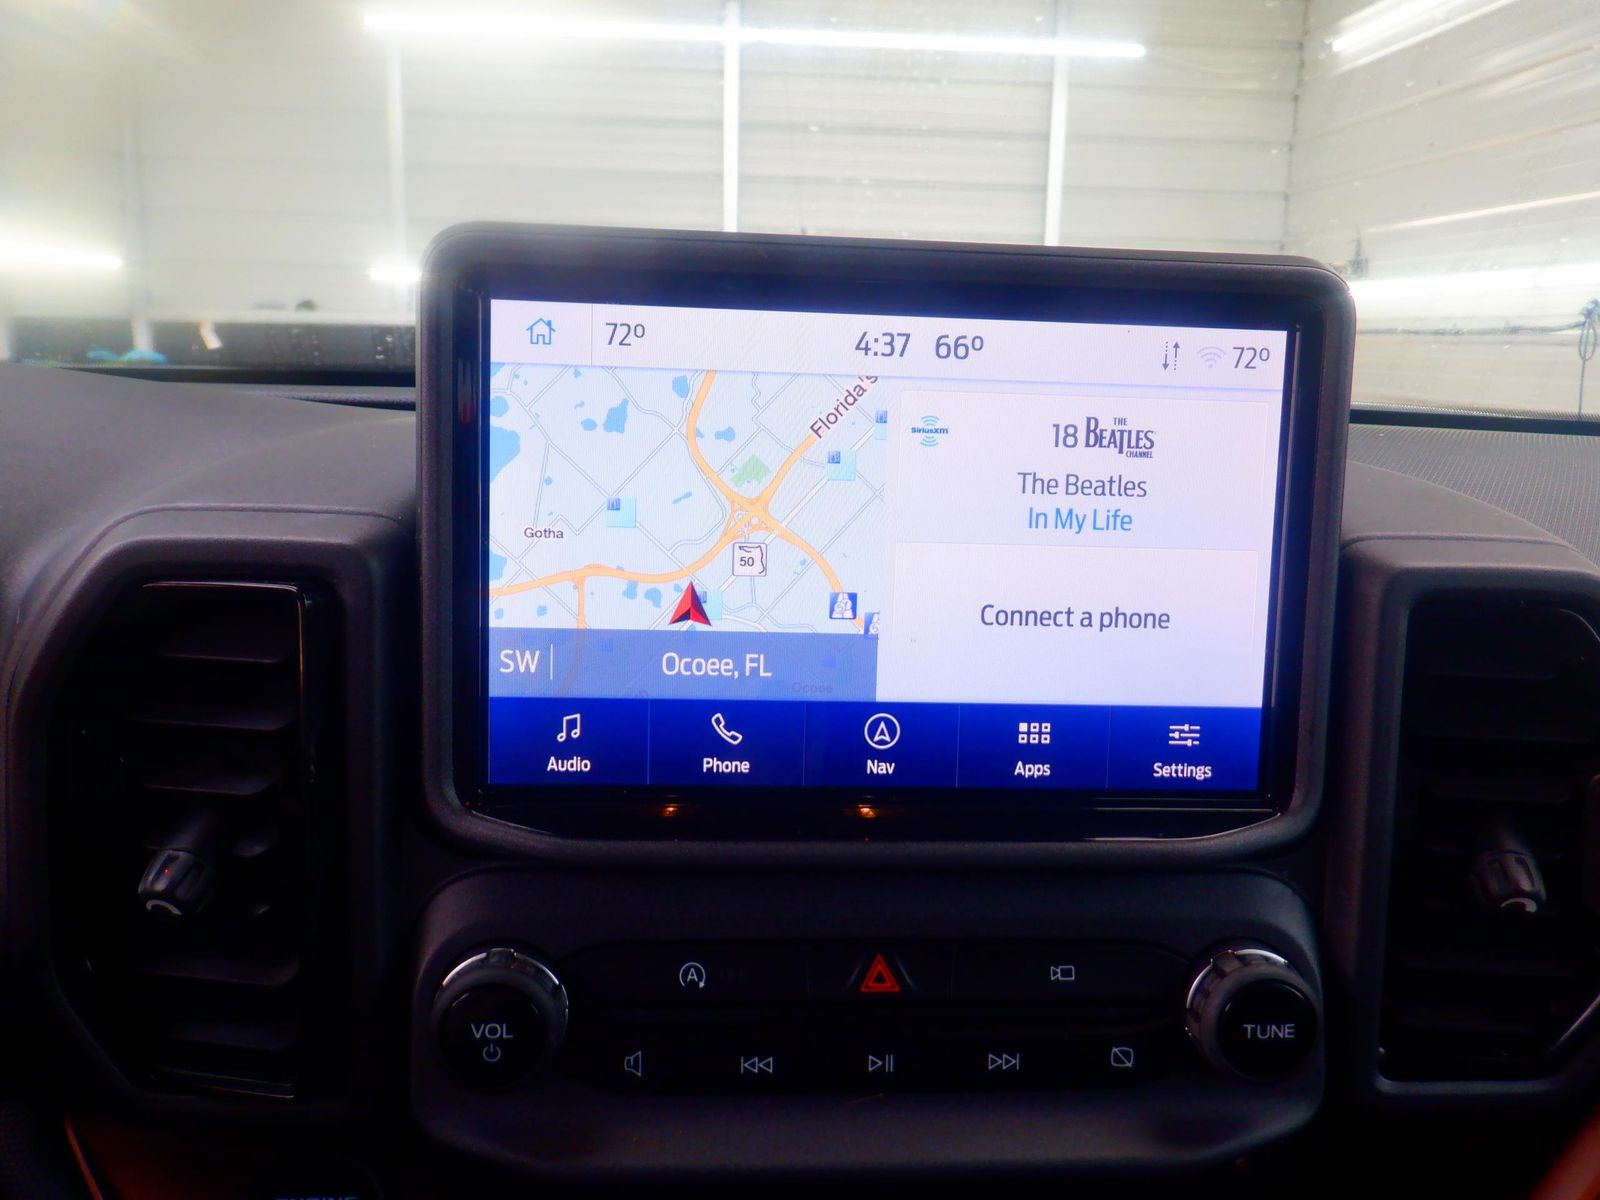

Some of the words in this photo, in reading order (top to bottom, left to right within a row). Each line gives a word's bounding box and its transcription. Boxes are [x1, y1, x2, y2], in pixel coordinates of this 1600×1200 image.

[854, 331, 912, 358] 4:37
[809, 375, 879, 439] Florida's
[1113, 416, 1129, 426] THE
[1052, 423, 1078, 448] 18
[1125, 450, 1154, 459] CHANNEL
[1017, 472, 1060, 496] The
[1065, 474, 1148, 498] Beatles
[1028, 507, 1049, 529] In
[1054, 508, 1087, 534] My
[1092, 508, 1133, 531] Life
[523, 527, 565, 540] Gotha
[739, 555, 755, 568] 50
[980, 604, 1075, 628] Connect
[1079, 610, 1094, 628] a
[1099, 607, 1171, 632] phone
[499, 649, 541, 673] SW
[661, 651, 740, 680] Ocoee,
[744, 653, 773, 677] FL
[546, 756, 592, 773] Audio
[702, 757, 751, 774] Phone
[866, 759, 896, 775] Nav
[1013, 761, 1052, 778] Apps
[1152, 762, 1213, 780] Settings
[471, 1023, 514, 1040] VOL
[1242, 1023, 1296, 1040] TUNE
